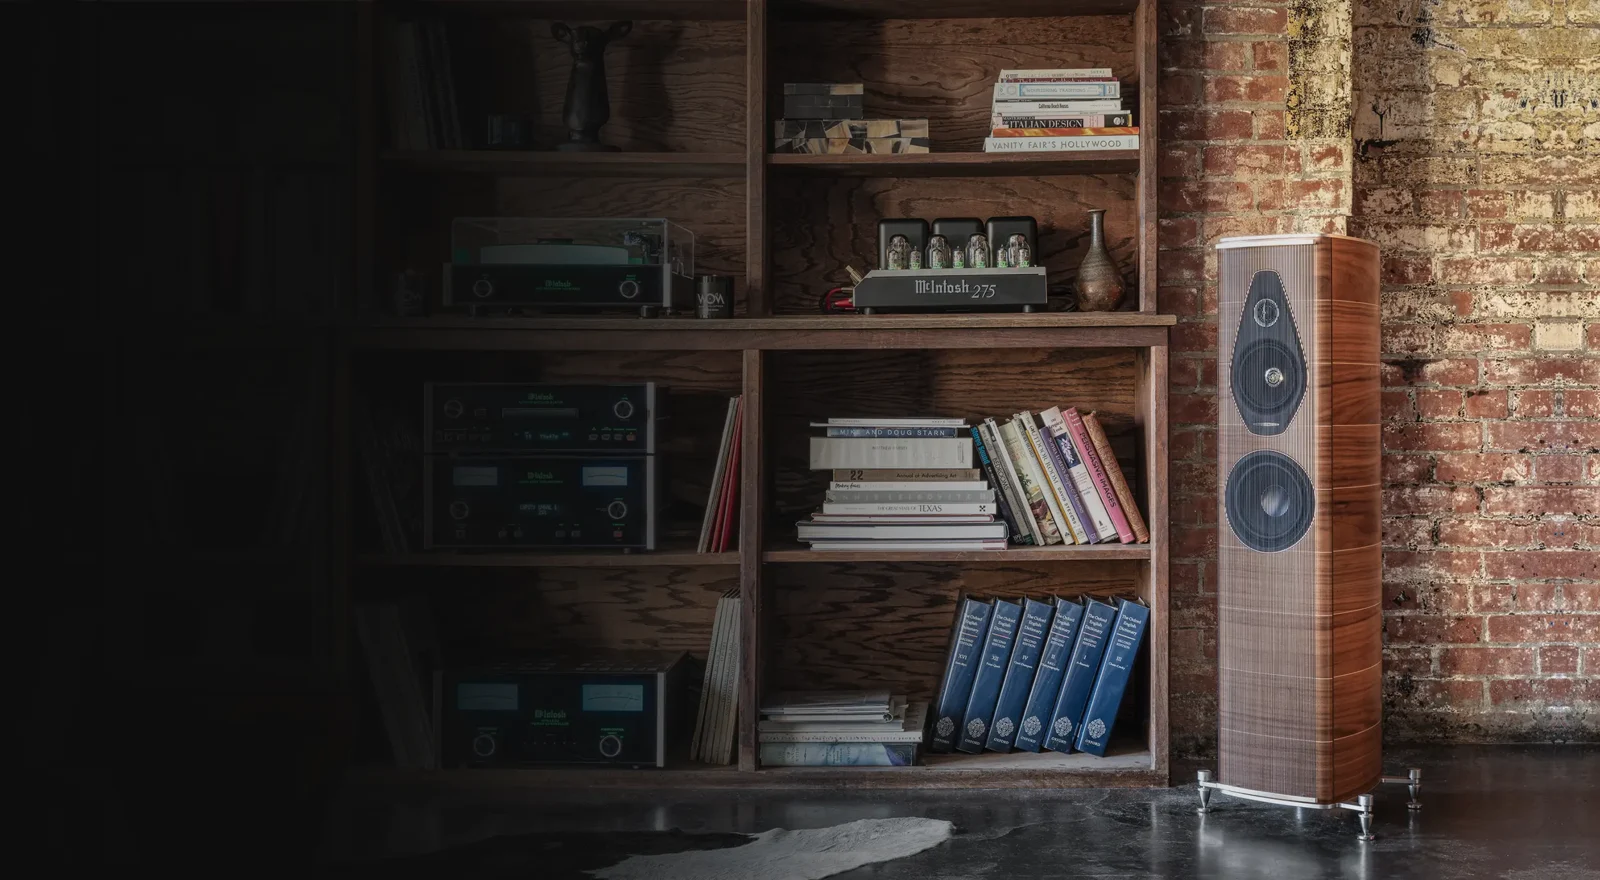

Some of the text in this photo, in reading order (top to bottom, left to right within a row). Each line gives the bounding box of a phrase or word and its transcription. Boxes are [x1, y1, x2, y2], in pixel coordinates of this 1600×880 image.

[1010, 120, 1046, 128] ITALIAN
[1049, 120, 1083, 128] DESIGN
[1061, 140, 1121, 148] HOLLYWOOD
[915, 279, 996, 298] McIntosh 275
[851, 470, 863, 480] 22
[993, 457, 1010, 490] BEDROOMS
[1045, 461, 1059, 484] ROOM
[1080, 432, 1103, 478] PERSUASIVE
[1100, 478, 1116, 508] IMAGES
